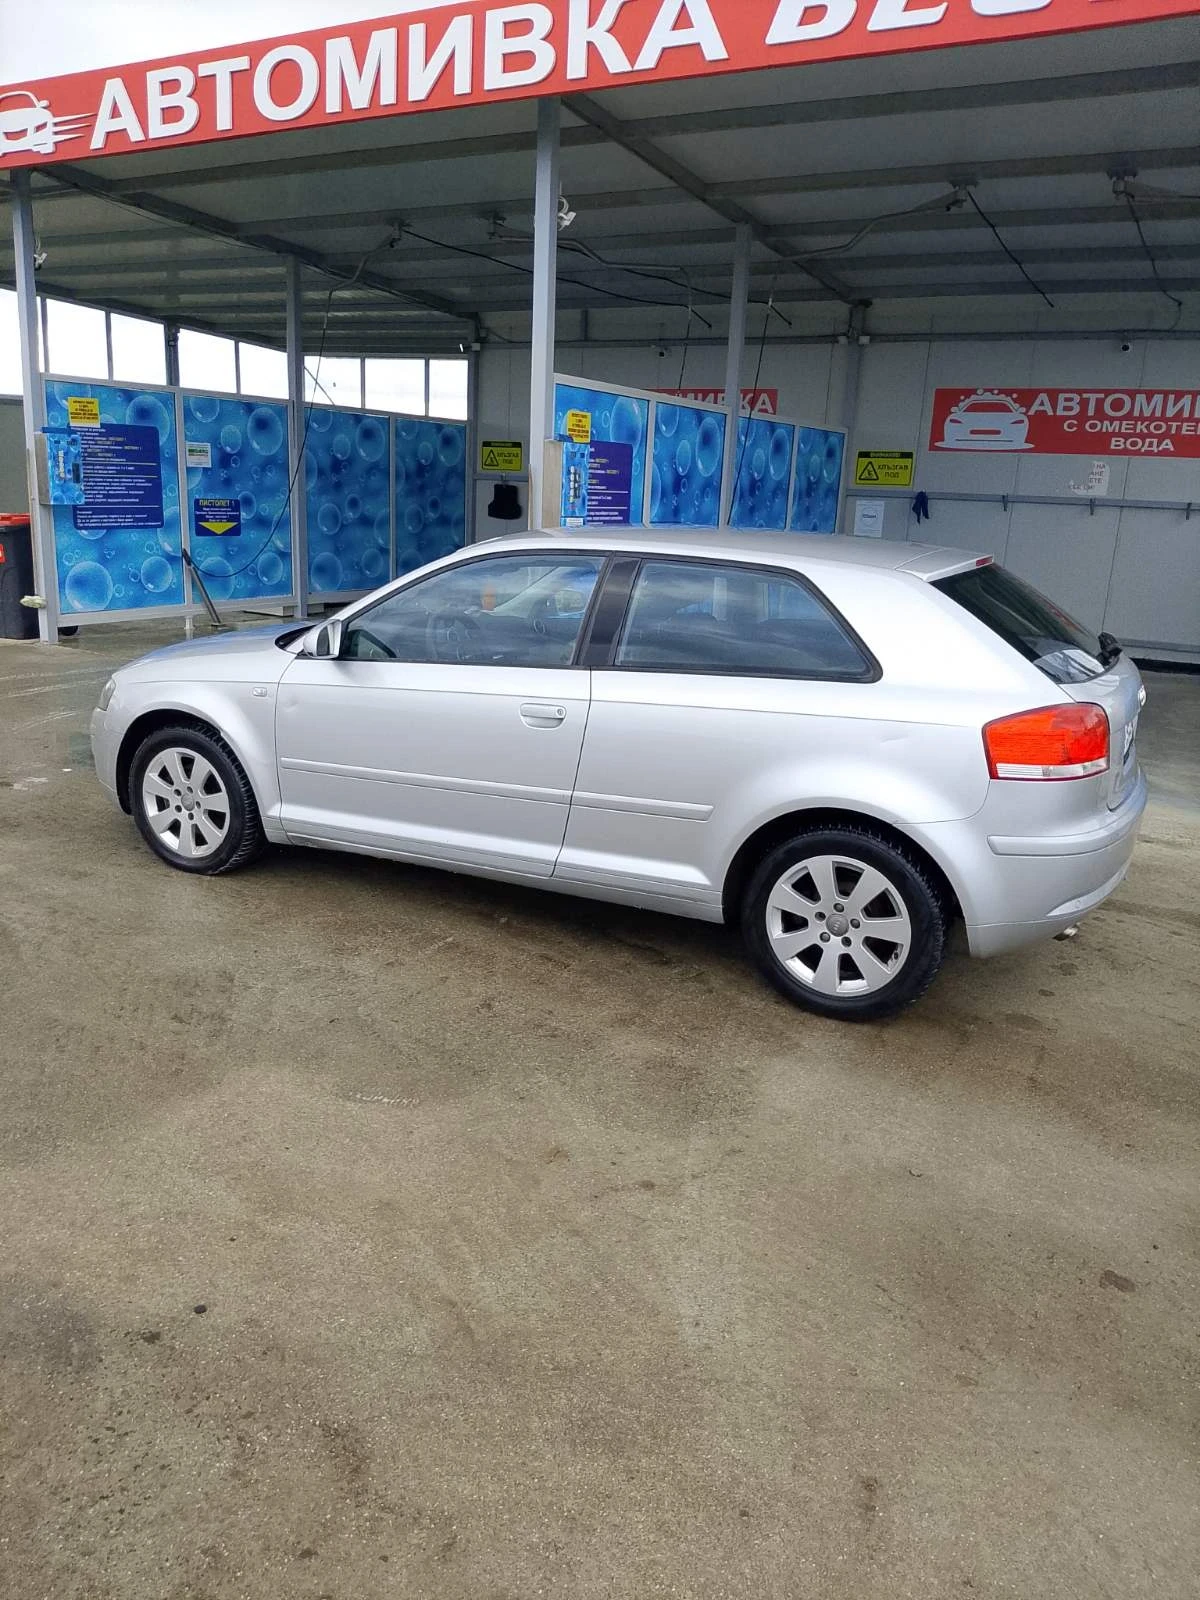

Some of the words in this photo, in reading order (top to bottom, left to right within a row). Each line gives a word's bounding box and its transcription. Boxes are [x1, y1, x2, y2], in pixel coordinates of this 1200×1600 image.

[89, 0, 729, 150] АВТОМИВКА
[1028, 393, 1200, 418] АВТОМИ
[1063, 419, 1079, 432] С
[1110, 437, 1175, 452] ВОДА
